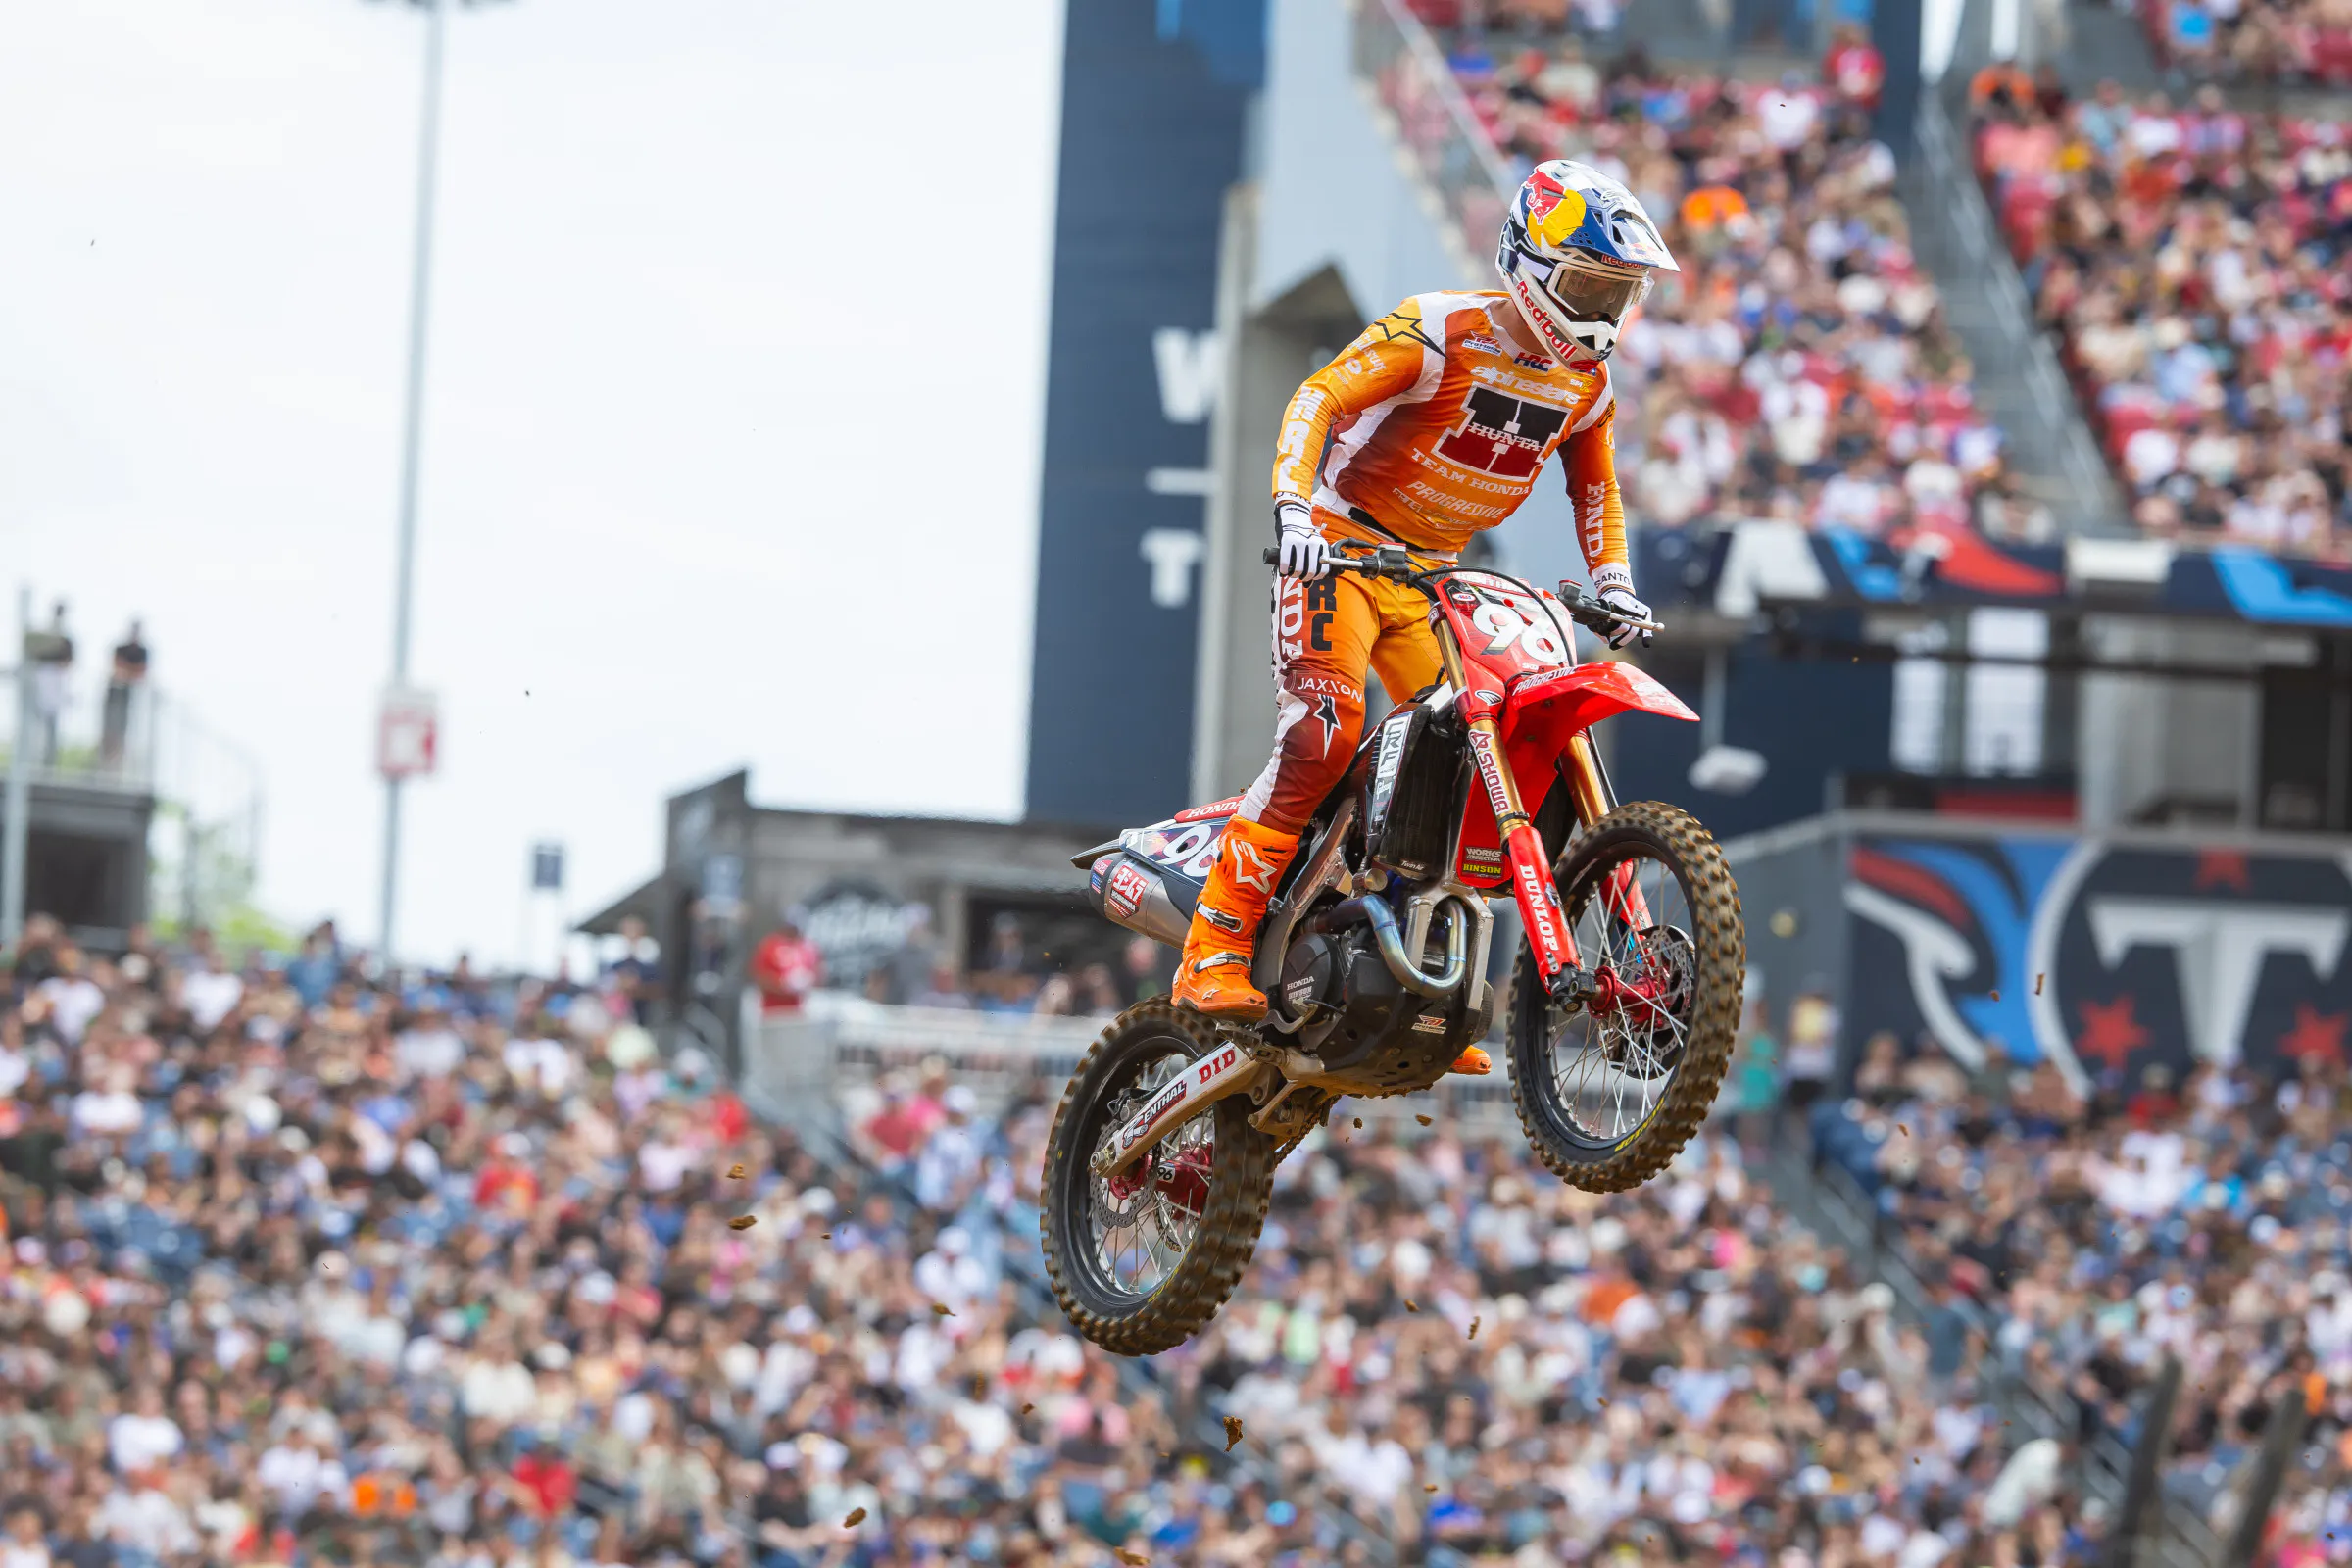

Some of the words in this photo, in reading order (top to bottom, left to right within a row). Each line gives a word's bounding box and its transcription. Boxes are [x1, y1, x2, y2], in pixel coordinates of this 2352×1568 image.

[1513, 351, 1553, 372] HRC
[1470, 366, 1582, 405] alpinestars
[1468, 421, 1543, 452] HUNTA
[1411, 447, 1467, 484] TEAM
[1468, 477, 1530, 496] HONDA
[1406, 480, 1509, 519] PROGRESSIVE
[1478, 752, 1509, 813] SHOWA
[1462, 863, 1502, 874] HINSON
[1465, 847, 1502, 858] WORKS
[1519, 864, 1559, 951] DUNLOP
[1286, 975, 1315, 991] HONDA
